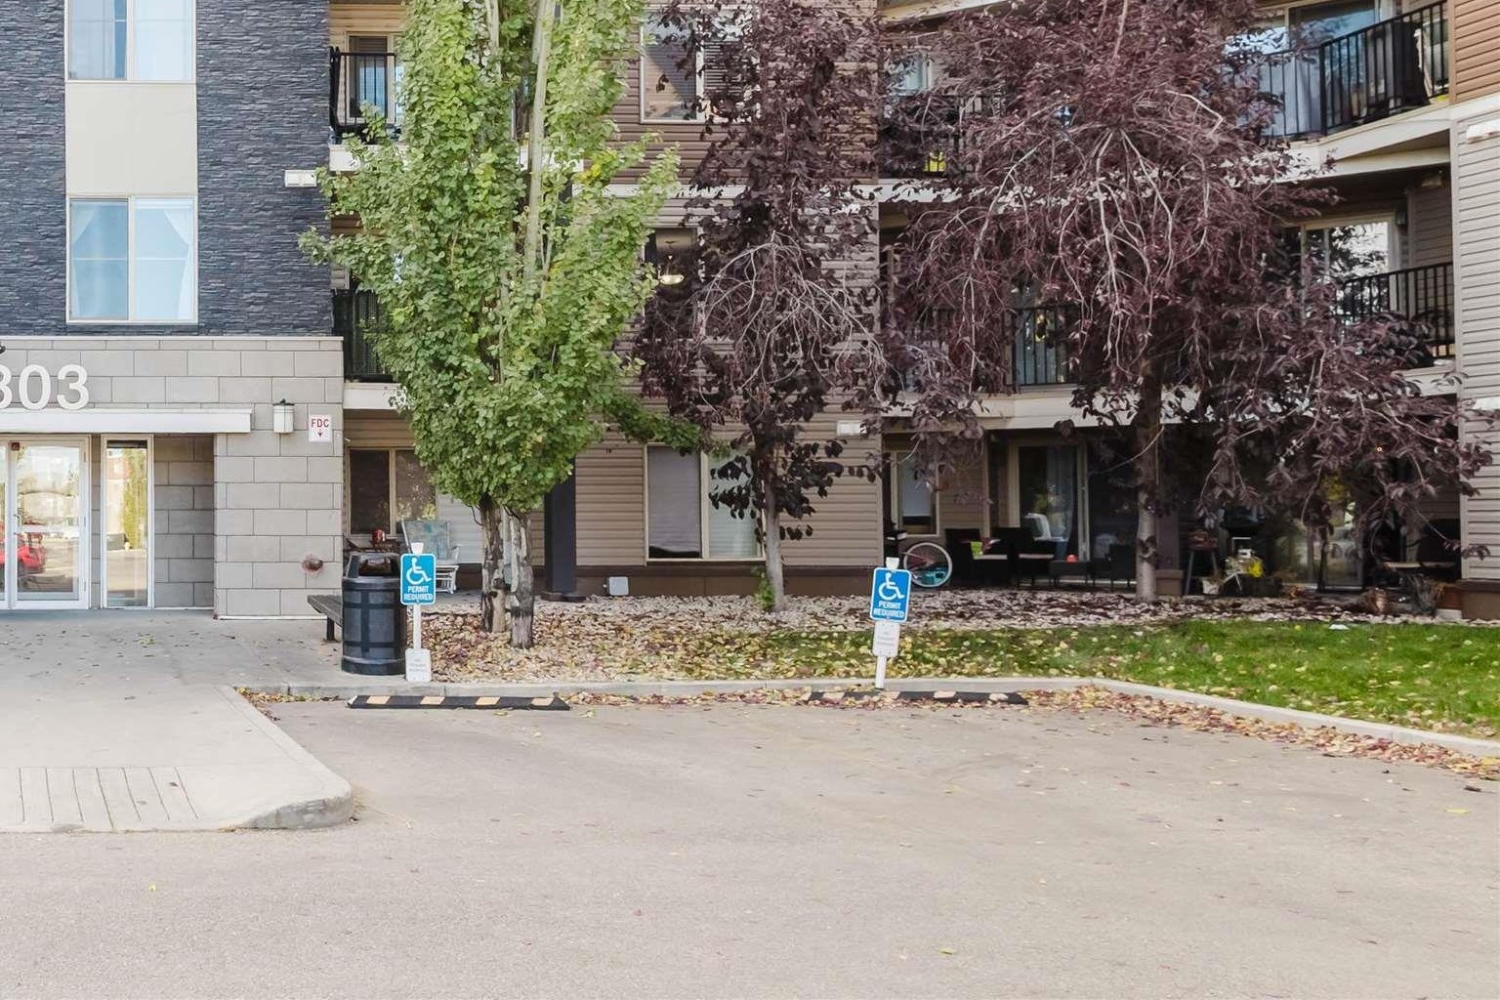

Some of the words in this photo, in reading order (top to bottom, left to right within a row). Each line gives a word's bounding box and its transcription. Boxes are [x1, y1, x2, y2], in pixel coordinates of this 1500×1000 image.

[311, 418, 329, 428] FDC
[407, 585, 429, 593] PERMIT
[403, 593, 434, 601] REQUIRED
[878, 600, 902, 610] PERMIT
[873, 607, 905, 618] REQUIRED
